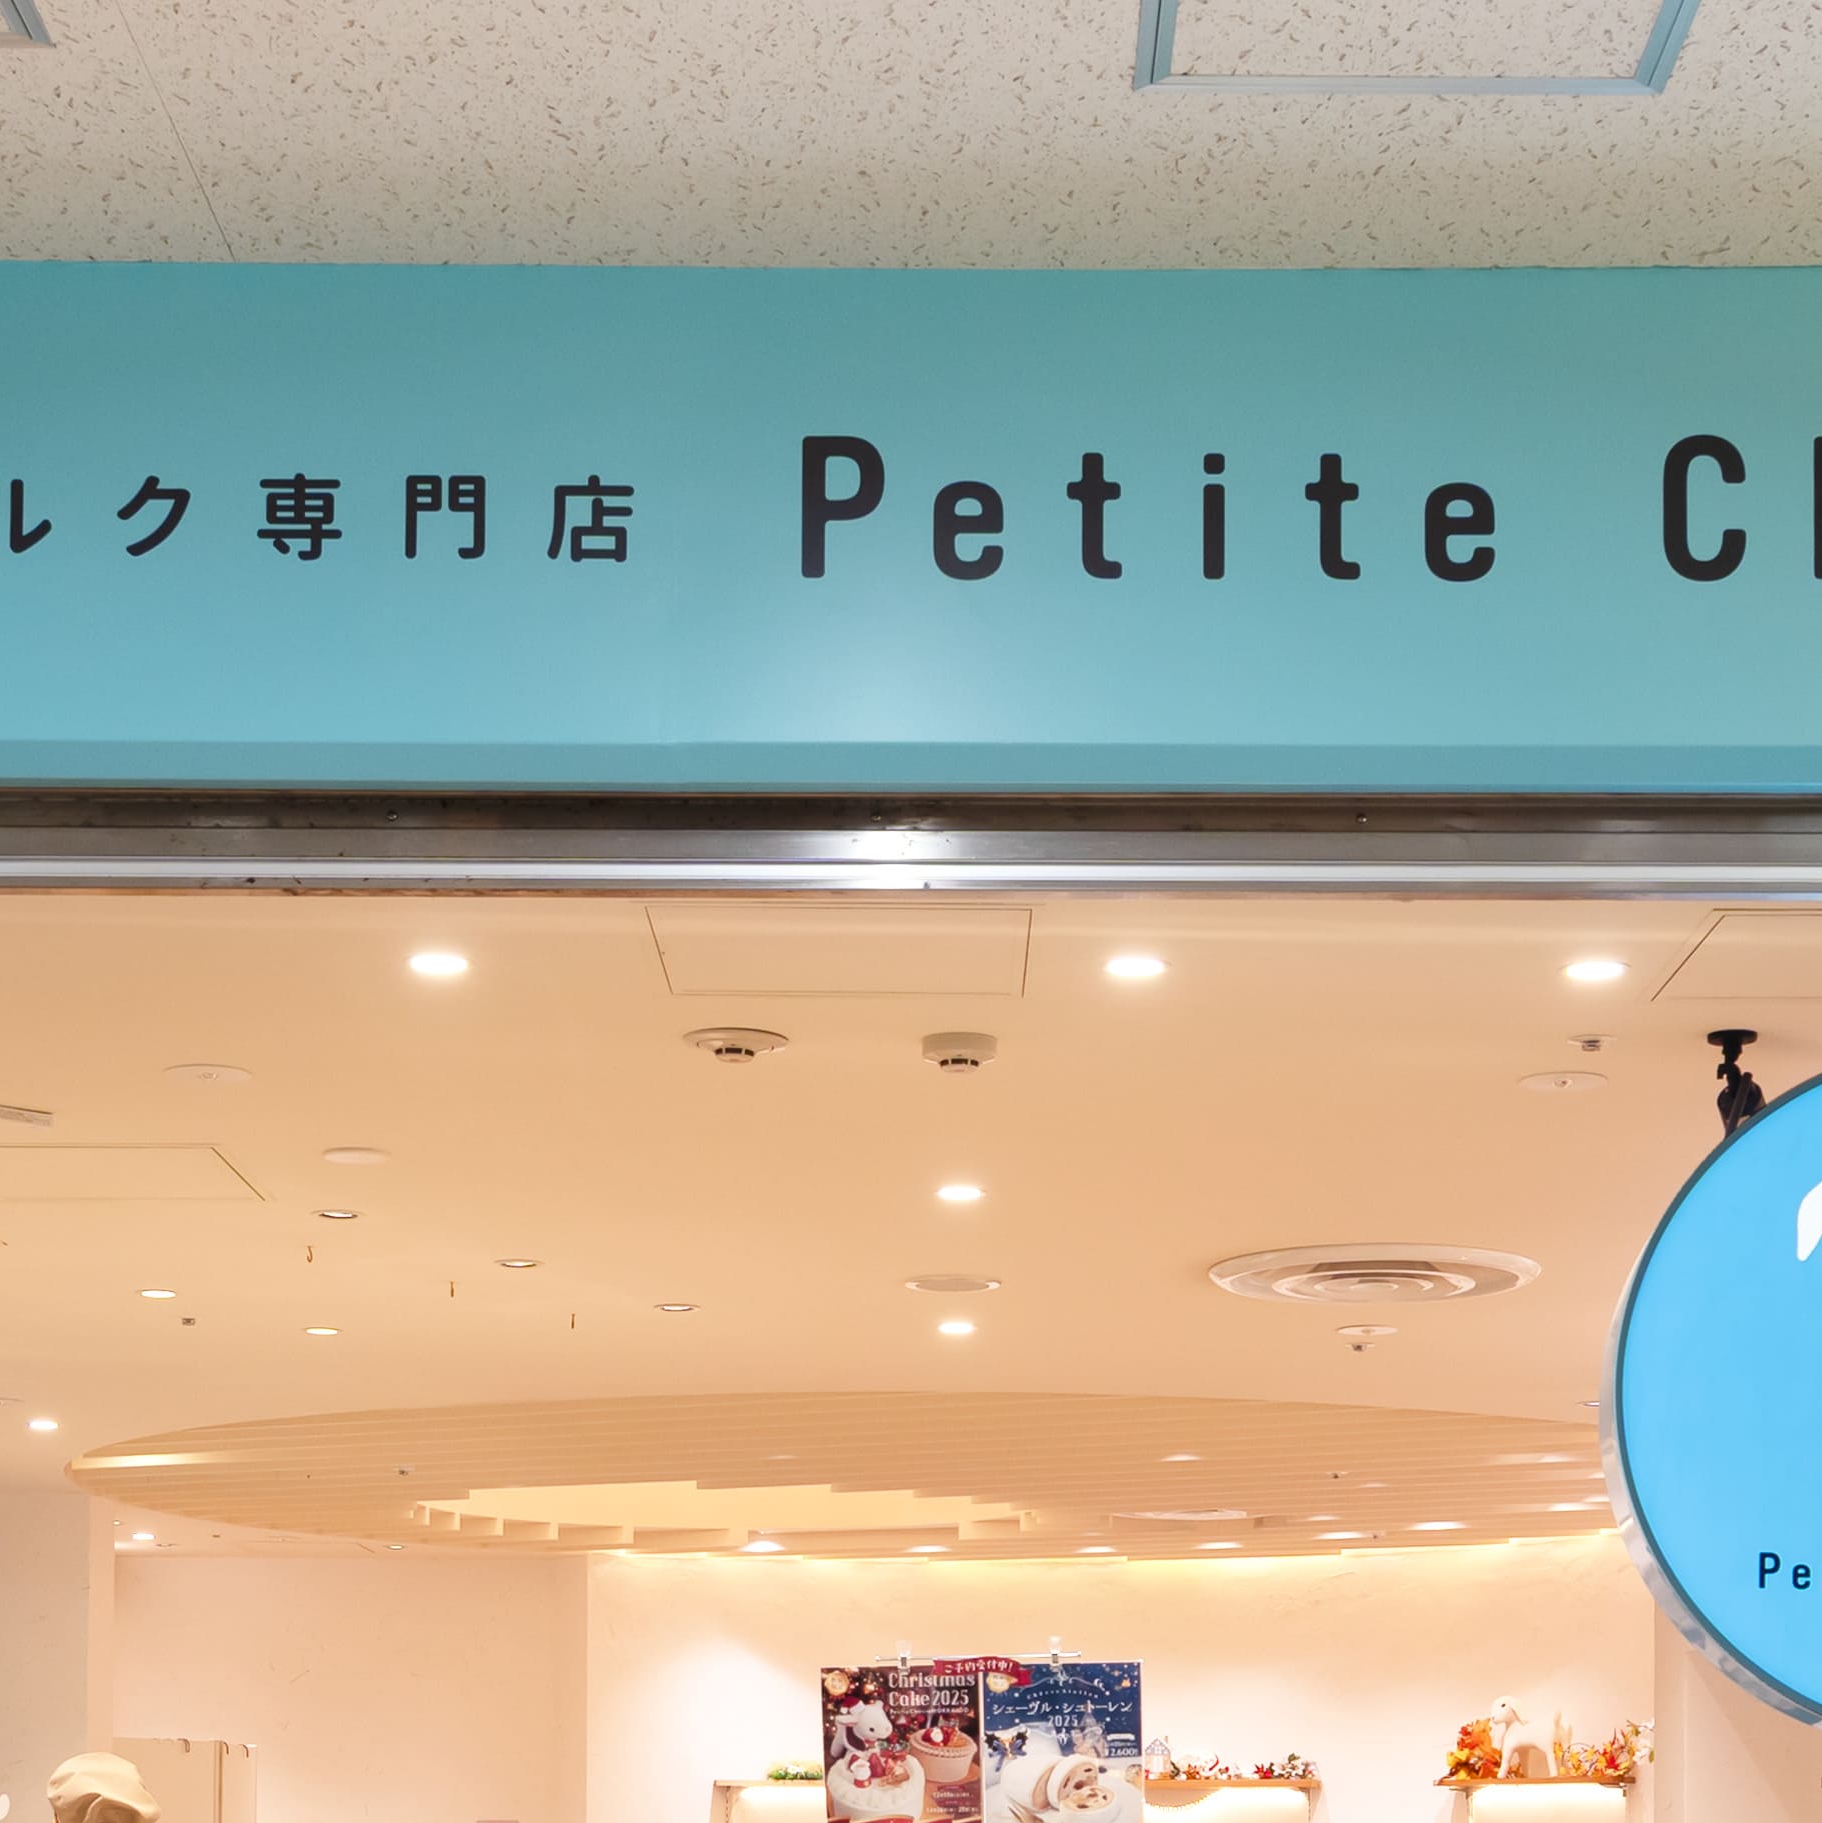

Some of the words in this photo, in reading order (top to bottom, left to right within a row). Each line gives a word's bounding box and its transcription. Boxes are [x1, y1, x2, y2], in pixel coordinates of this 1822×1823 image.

[800, 434, 1497, 582] Petite
[888, 1690, 930, 1706] Cake
[931, 1689, 970, 1706] 2025
[1047, 1714, 1078, 1727] 2025
